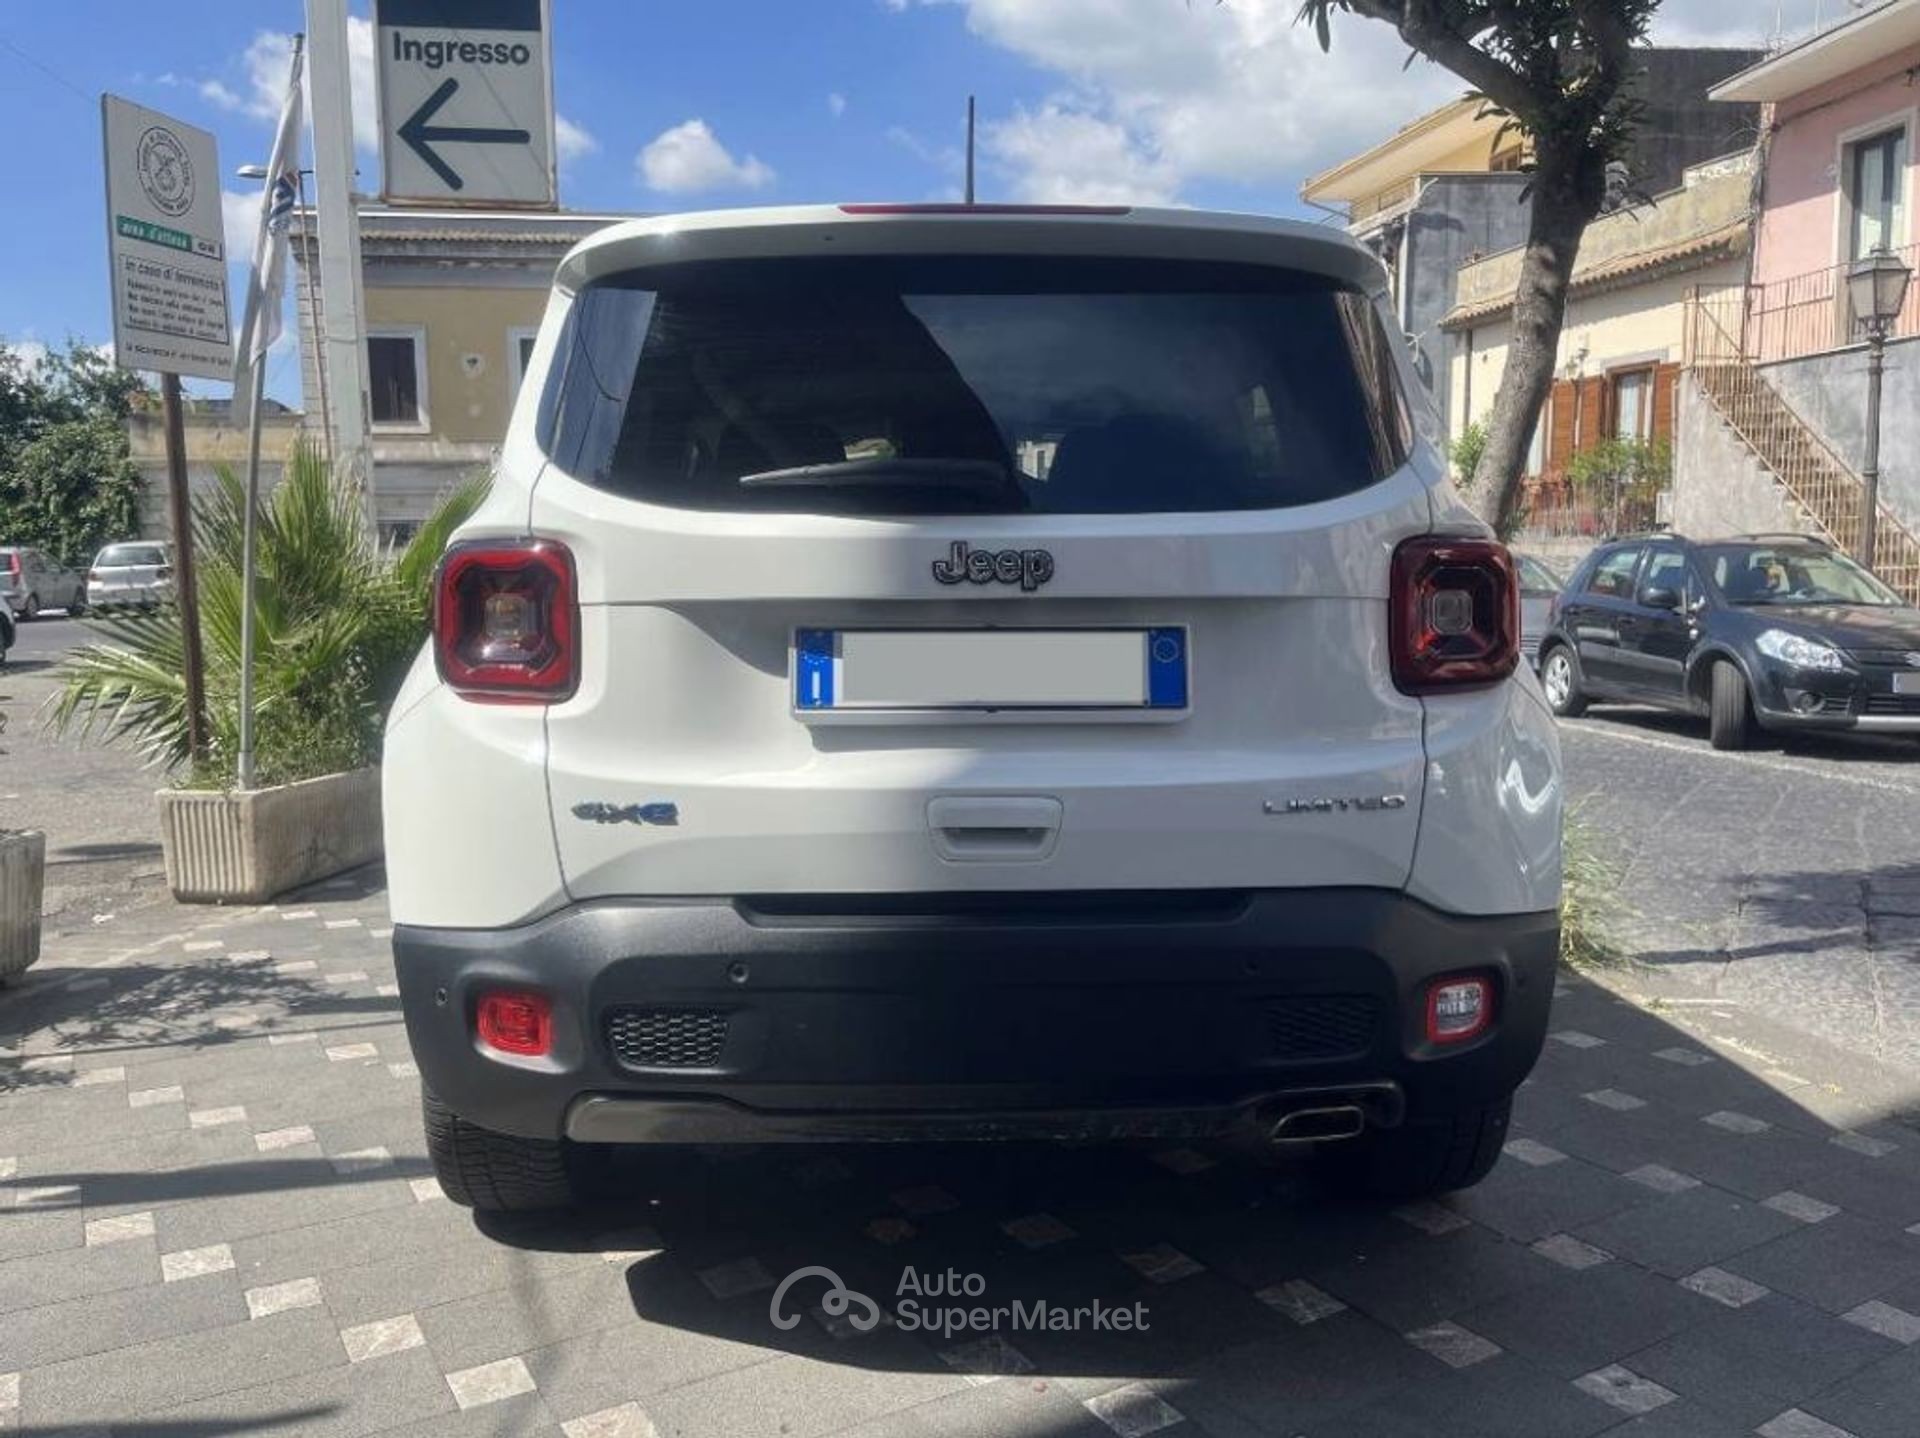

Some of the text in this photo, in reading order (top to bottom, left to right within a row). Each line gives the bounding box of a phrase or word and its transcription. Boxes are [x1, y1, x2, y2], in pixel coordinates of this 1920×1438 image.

[393, 31, 530, 69] Ingresso
[932, 540, 1055, 592] Jeep
[1263, 794, 1406, 815] LIMITED
